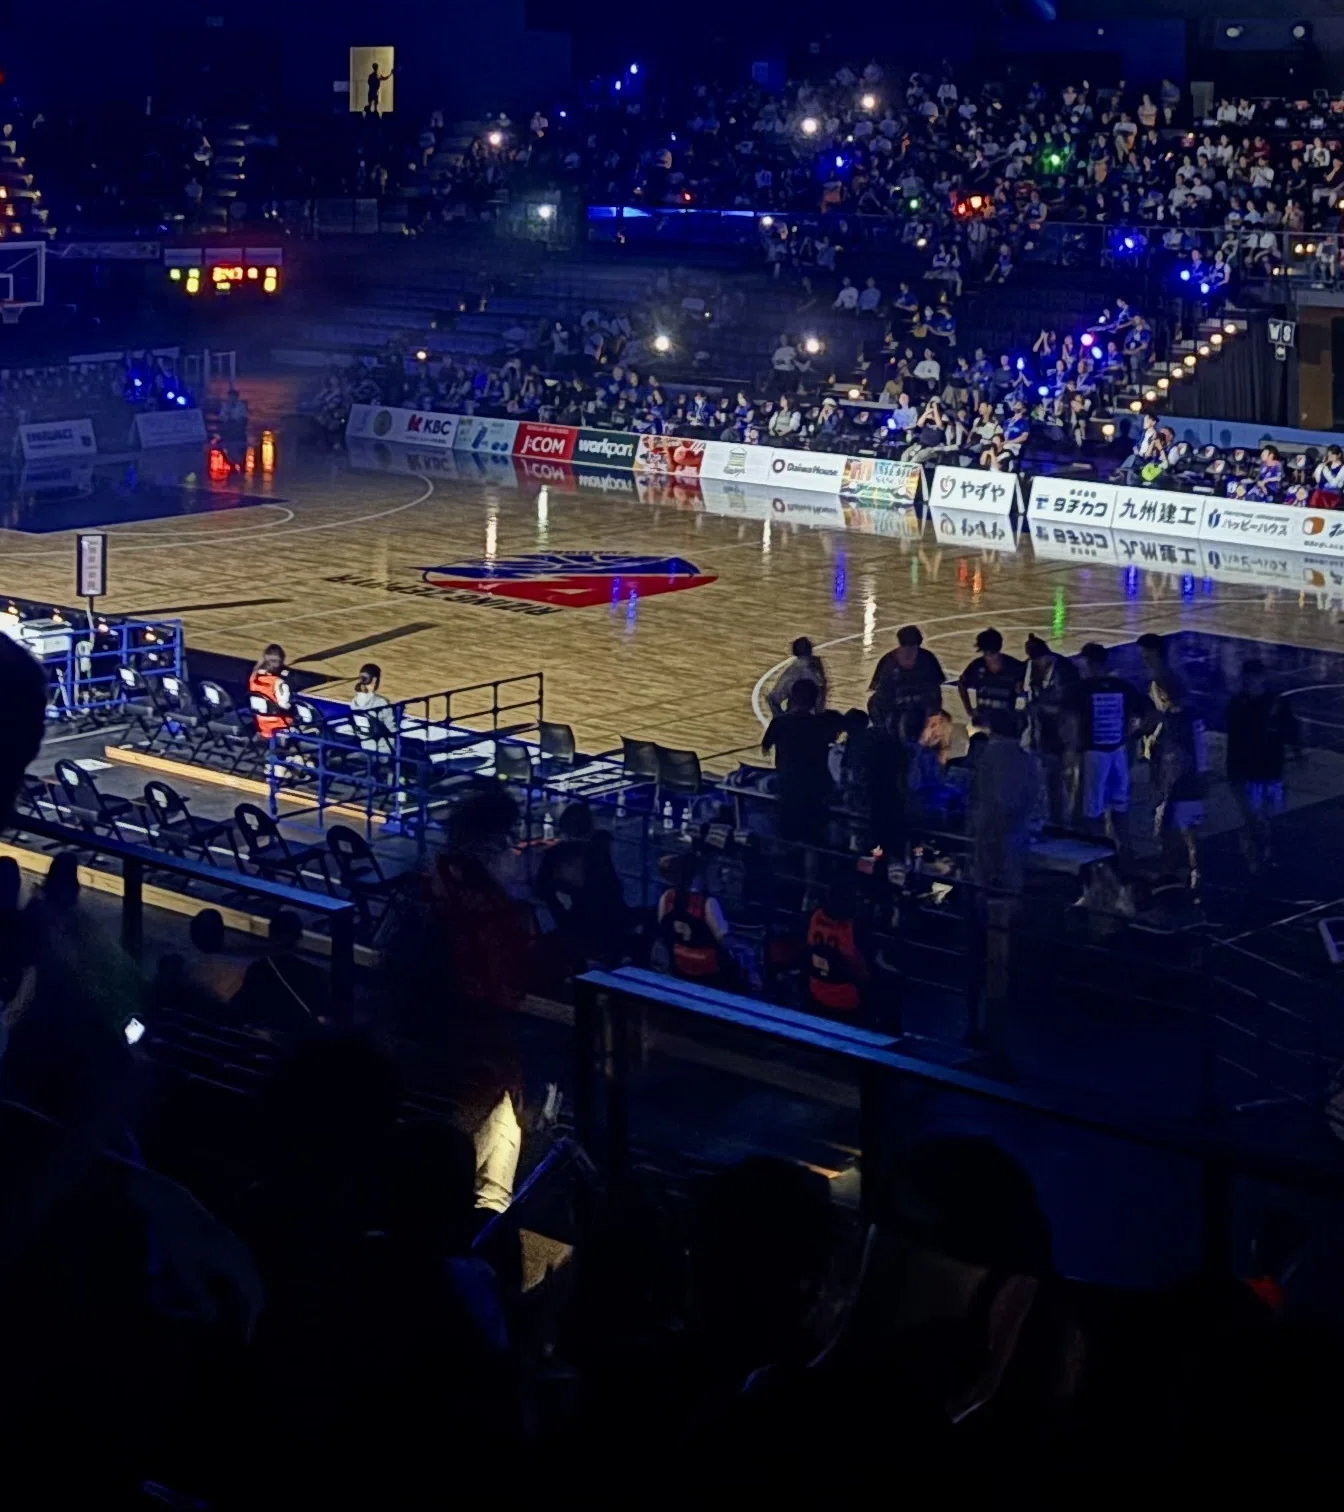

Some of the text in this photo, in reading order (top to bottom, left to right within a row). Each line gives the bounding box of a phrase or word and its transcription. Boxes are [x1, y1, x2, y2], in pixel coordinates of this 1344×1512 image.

[423, 418, 452, 436] KBC
[520, 435, 565, 455] J:COM
[578, 437, 634, 458] workport
[960, 480, 1006, 503] やずや
[1118, 497, 1197, 525] 九州建工
[1221, 519, 1288, 537] ハッピーハウス
